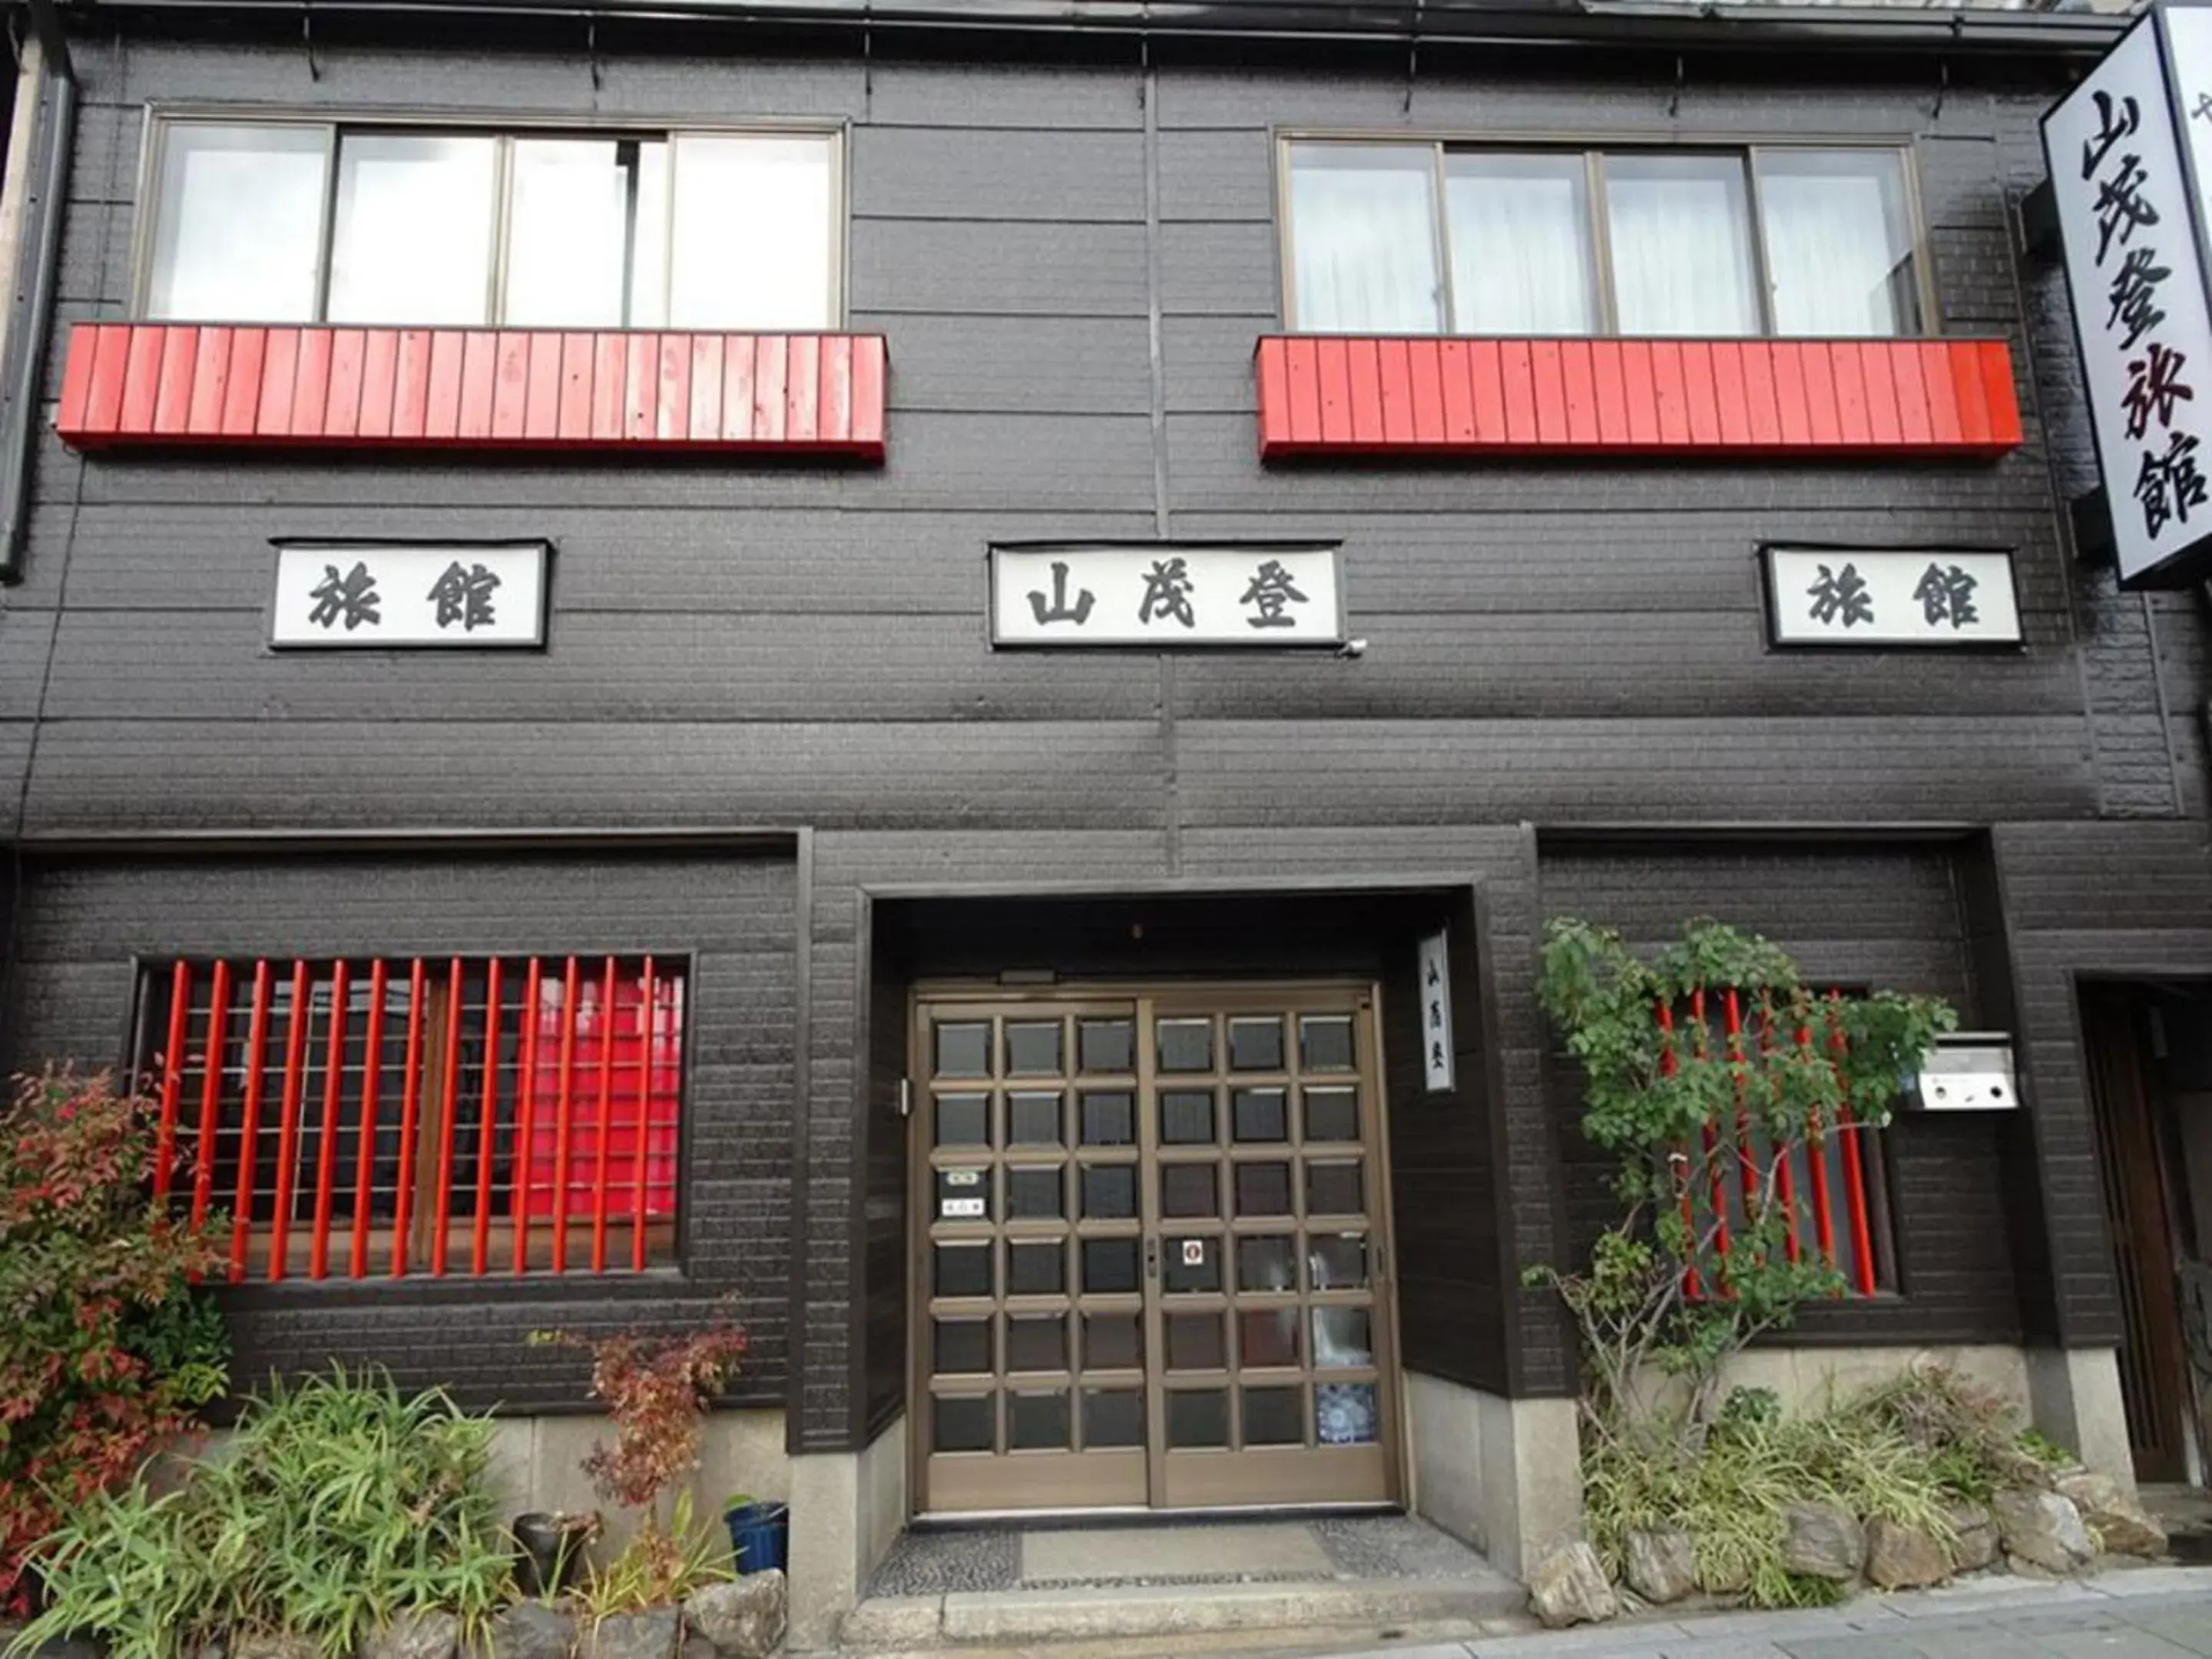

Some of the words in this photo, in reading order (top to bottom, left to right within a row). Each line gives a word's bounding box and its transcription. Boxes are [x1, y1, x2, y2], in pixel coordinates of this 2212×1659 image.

[2082, 90, 2209, 539] 山茂登旅館
[309, 561, 501, 631] 旅館
[1026, 557, 1310, 628] 山茂登
[1806, 562, 1979, 629] 旅館
